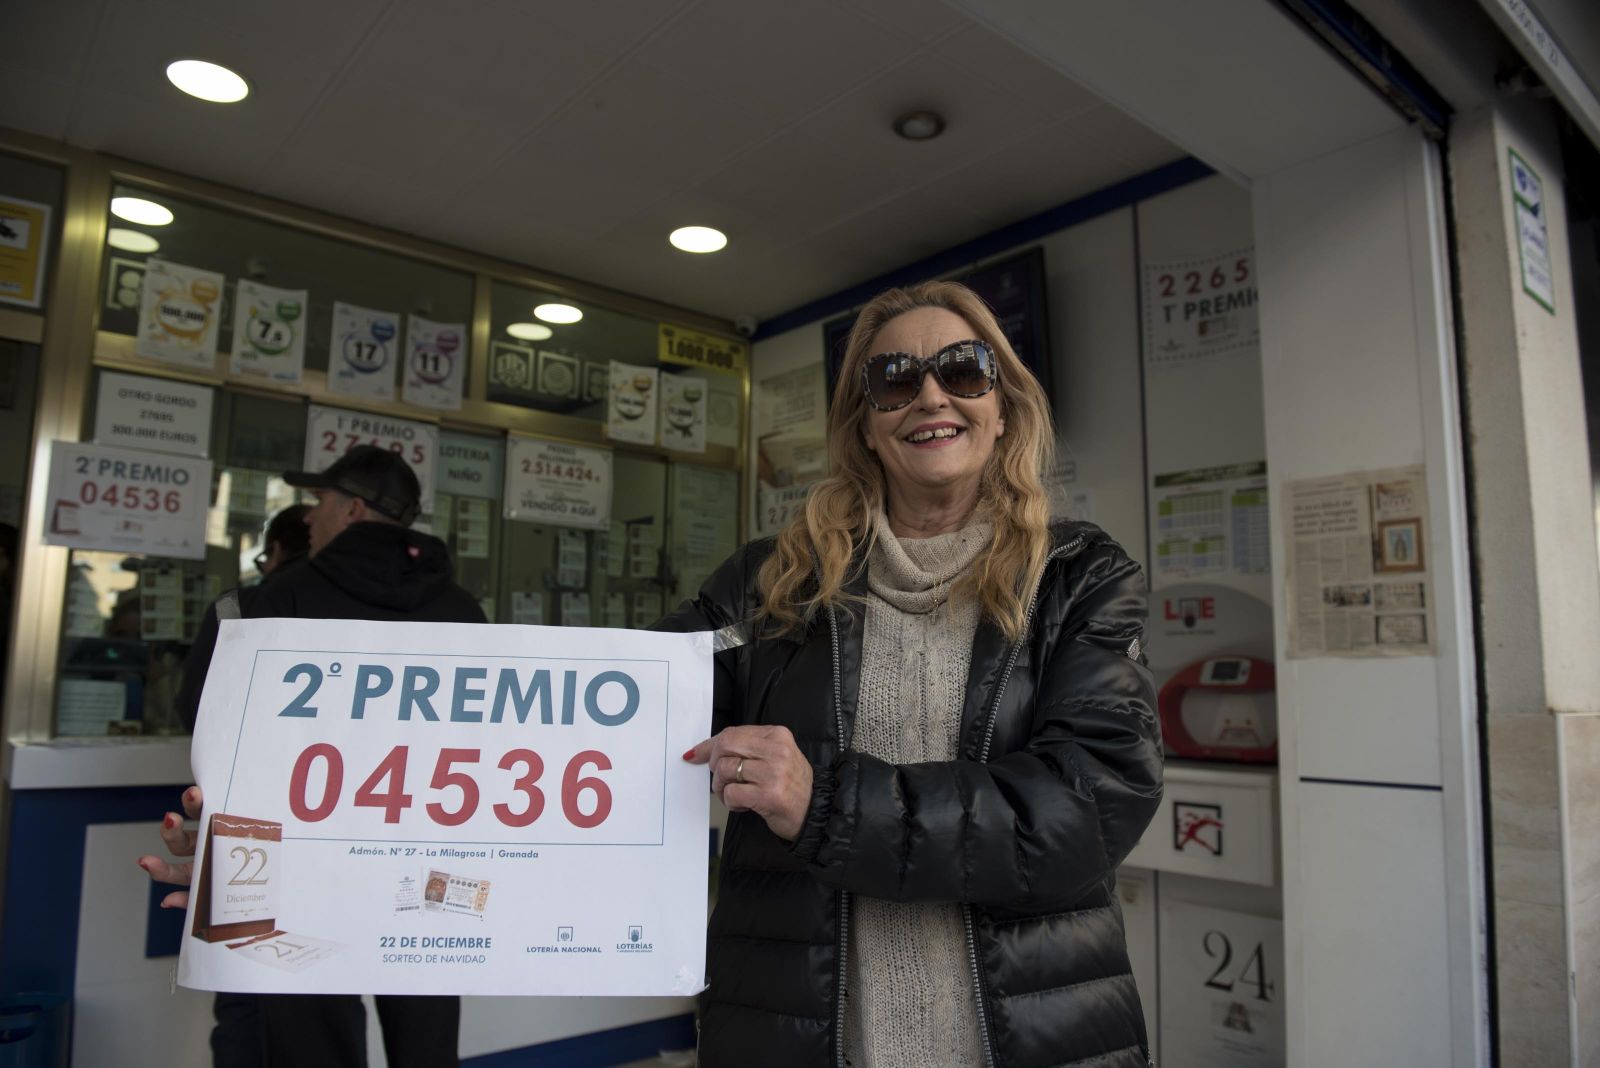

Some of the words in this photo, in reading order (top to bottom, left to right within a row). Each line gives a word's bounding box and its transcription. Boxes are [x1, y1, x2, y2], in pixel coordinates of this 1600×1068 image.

[355, 341, 377, 360] 17
[420, 353, 439, 372] 11
[352, 418, 415, 440] PREMIO
[98, 459, 190, 485] PREMIO
[80, 480, 181, 513] 04536
[278, 662, 342, 718] 2º
[350, 664, 641, 727] PREMIO
[289, 743, 614, 829] 04536
[349, 846, 387, 857] Admón.
[404, 848, 417, 857] 27
[426, 848, 437, 858] La
[440, 848, 486, 860] Milagrosa
[498, 850, 539, 859] Granada
[228, 846, 269, 886] 22
[226, 893, 267, 904] Diciembre
[380, 936, 396, 948] 22
[400, 937, 417, 949] DE
[421, 937, 492, 949] DICIEMBRE
[526, 945, 559, 953] LOTERÍA
[382, 953, 422, 964] SORTEO
[425, 954, 438, 964] DE
[441, 954, 487, 965] NAVIDAD
[1203, 929, 1274, 1004] 24
